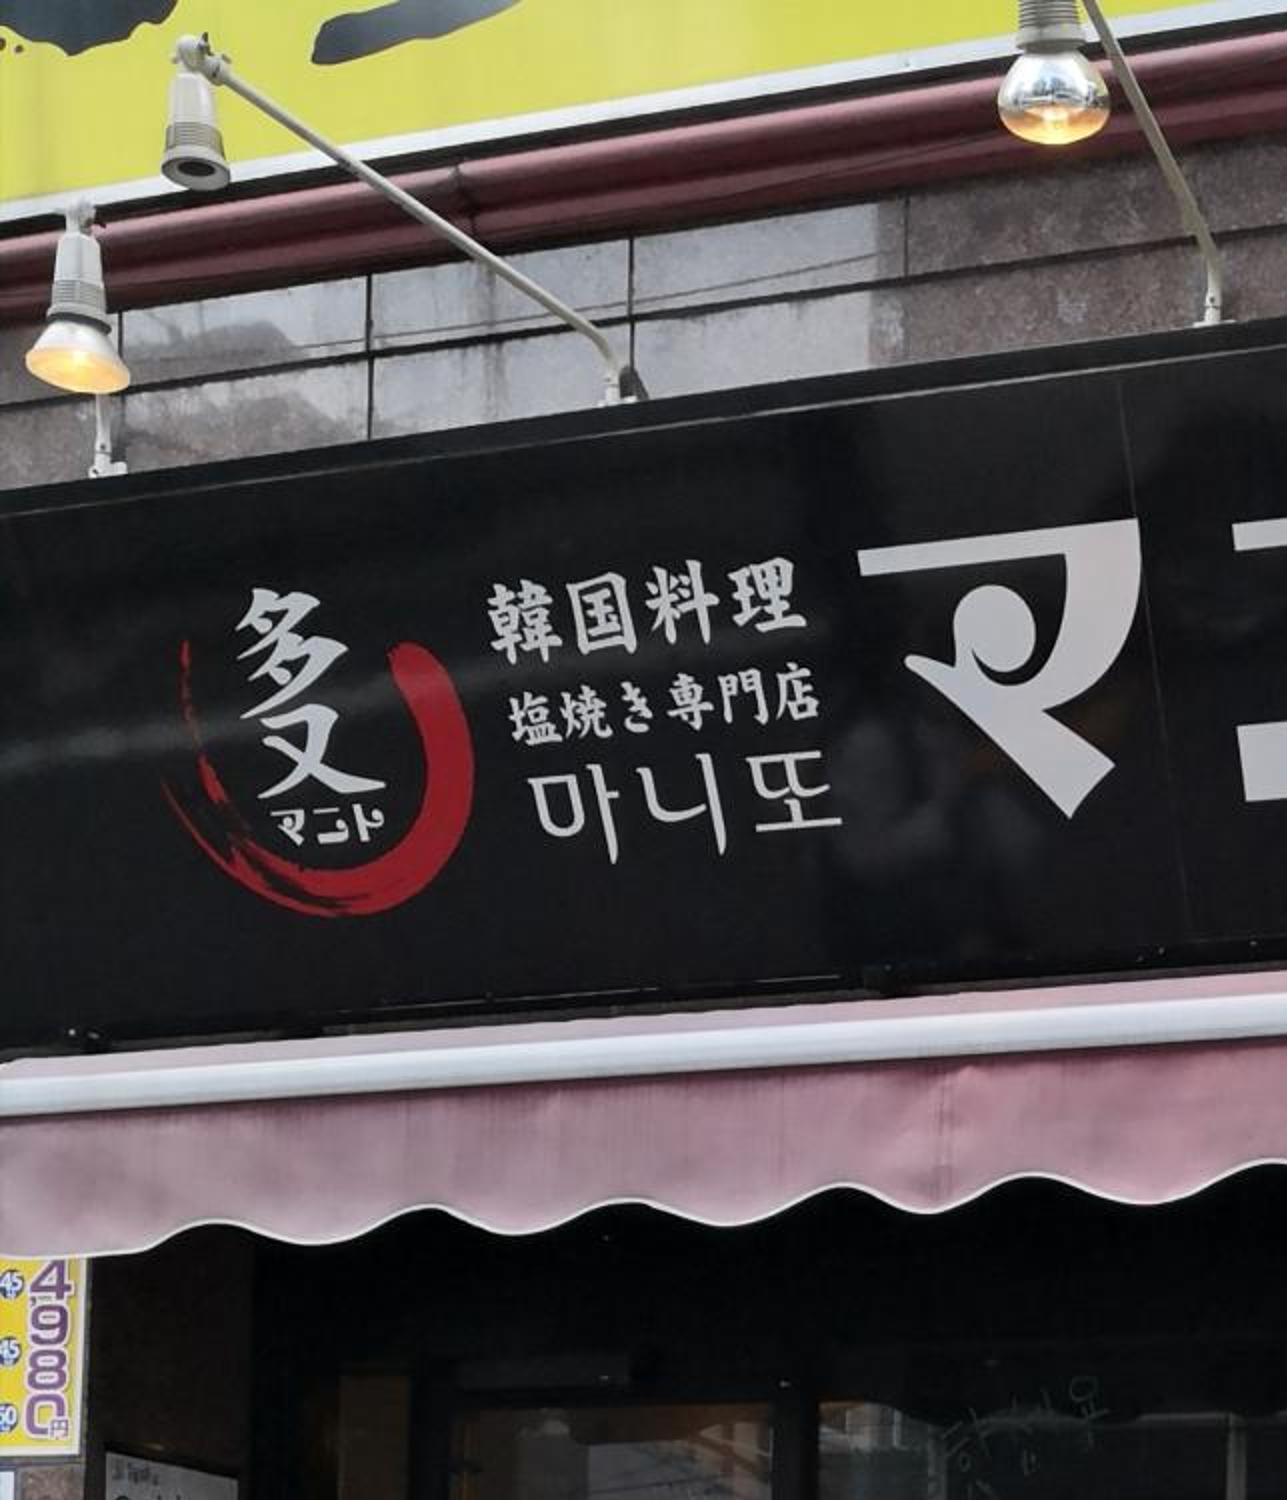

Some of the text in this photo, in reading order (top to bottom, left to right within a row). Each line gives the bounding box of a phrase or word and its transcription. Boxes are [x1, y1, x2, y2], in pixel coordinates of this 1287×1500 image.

[487, 556, 808, 664] 韓国料理
[236, 589, 387, 798] 多又
[508, 662, 820, 748] 塩焼き専門店
[527, 750, 843, 864] 마니또
